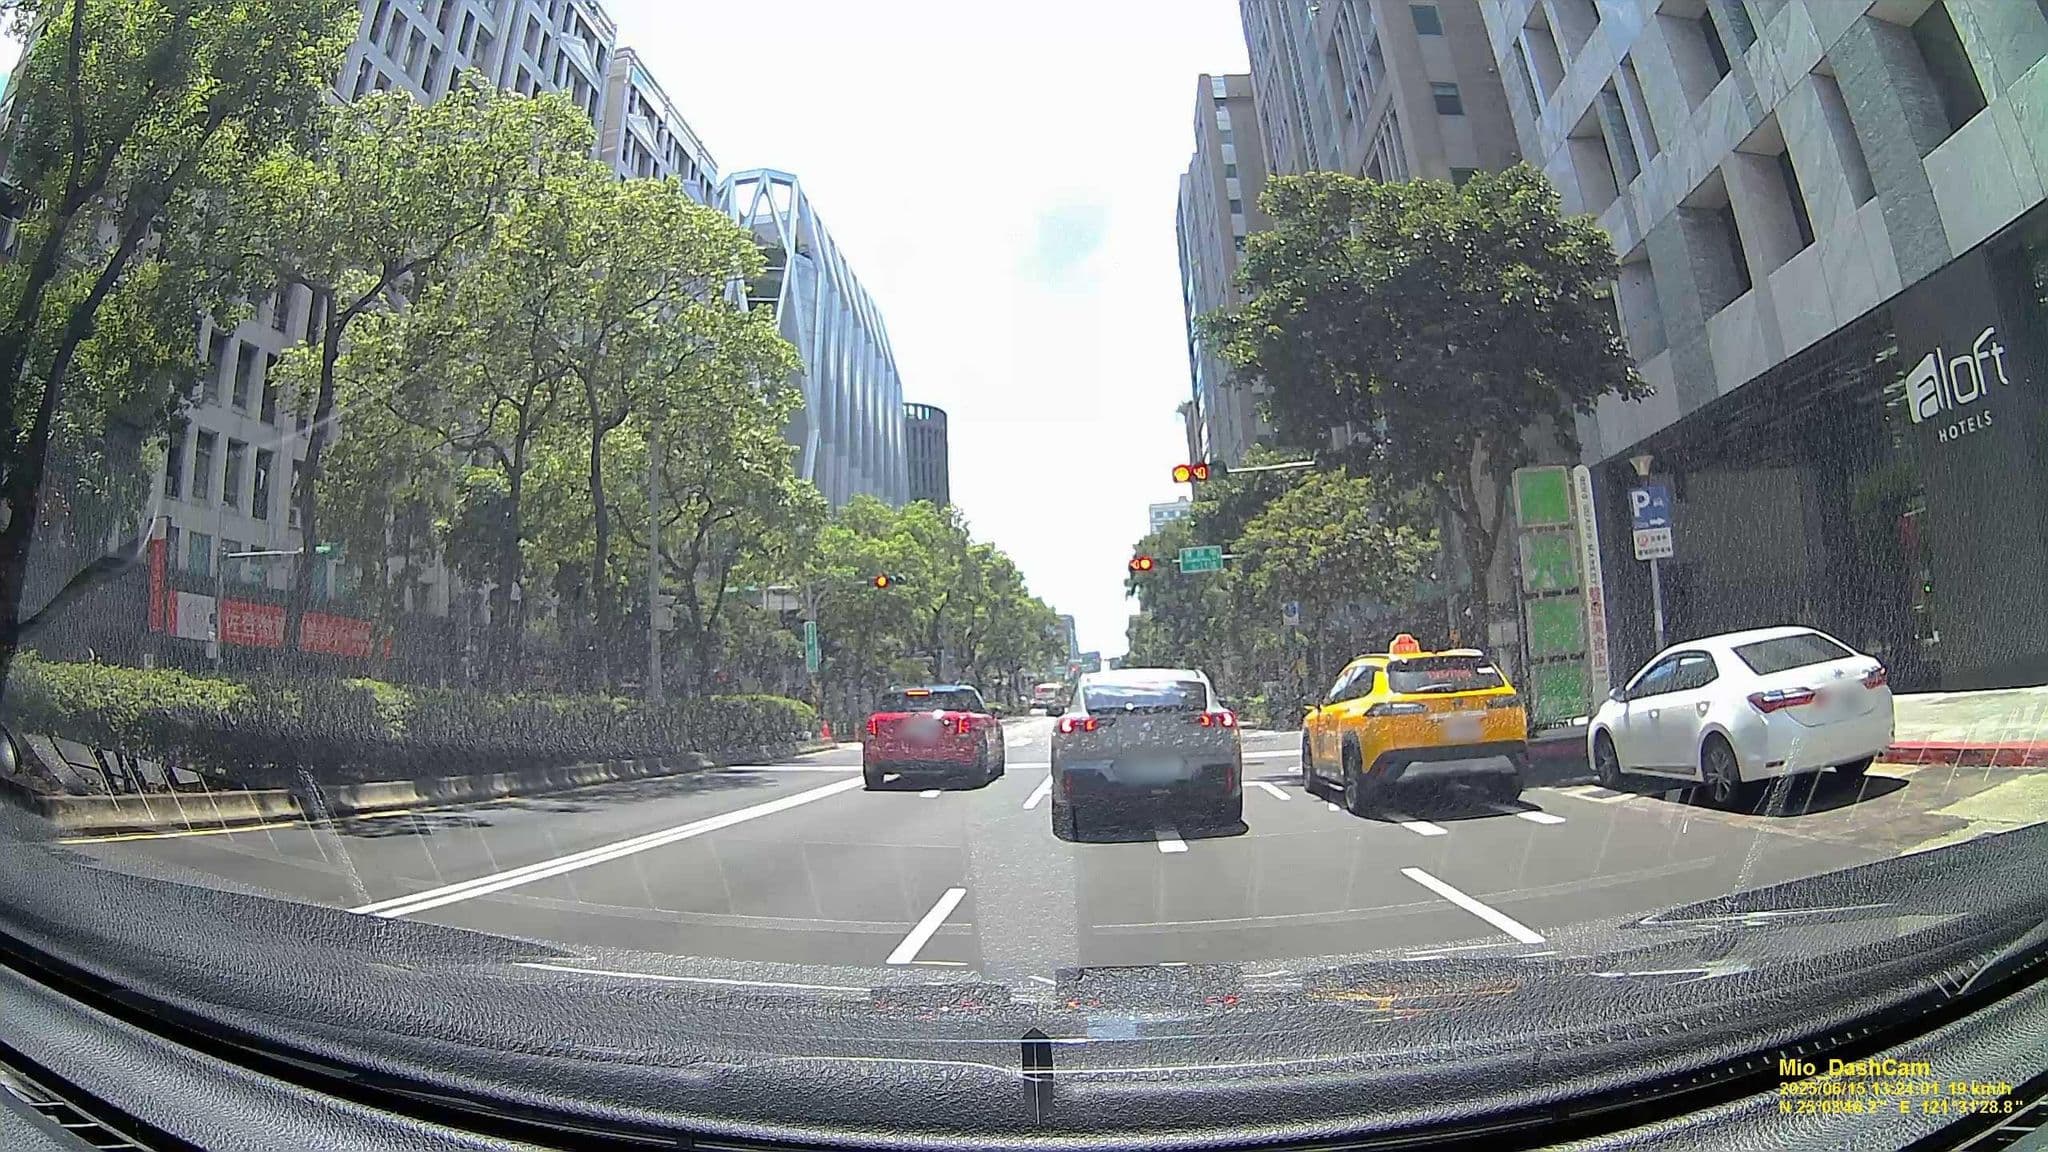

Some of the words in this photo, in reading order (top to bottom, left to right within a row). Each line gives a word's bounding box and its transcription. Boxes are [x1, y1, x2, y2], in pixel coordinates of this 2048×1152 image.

[1905, 327, 2010, 424] aloft
[1938, 410, 1993, 443] HOTELS
[1631, 490, 1650, 517] P
